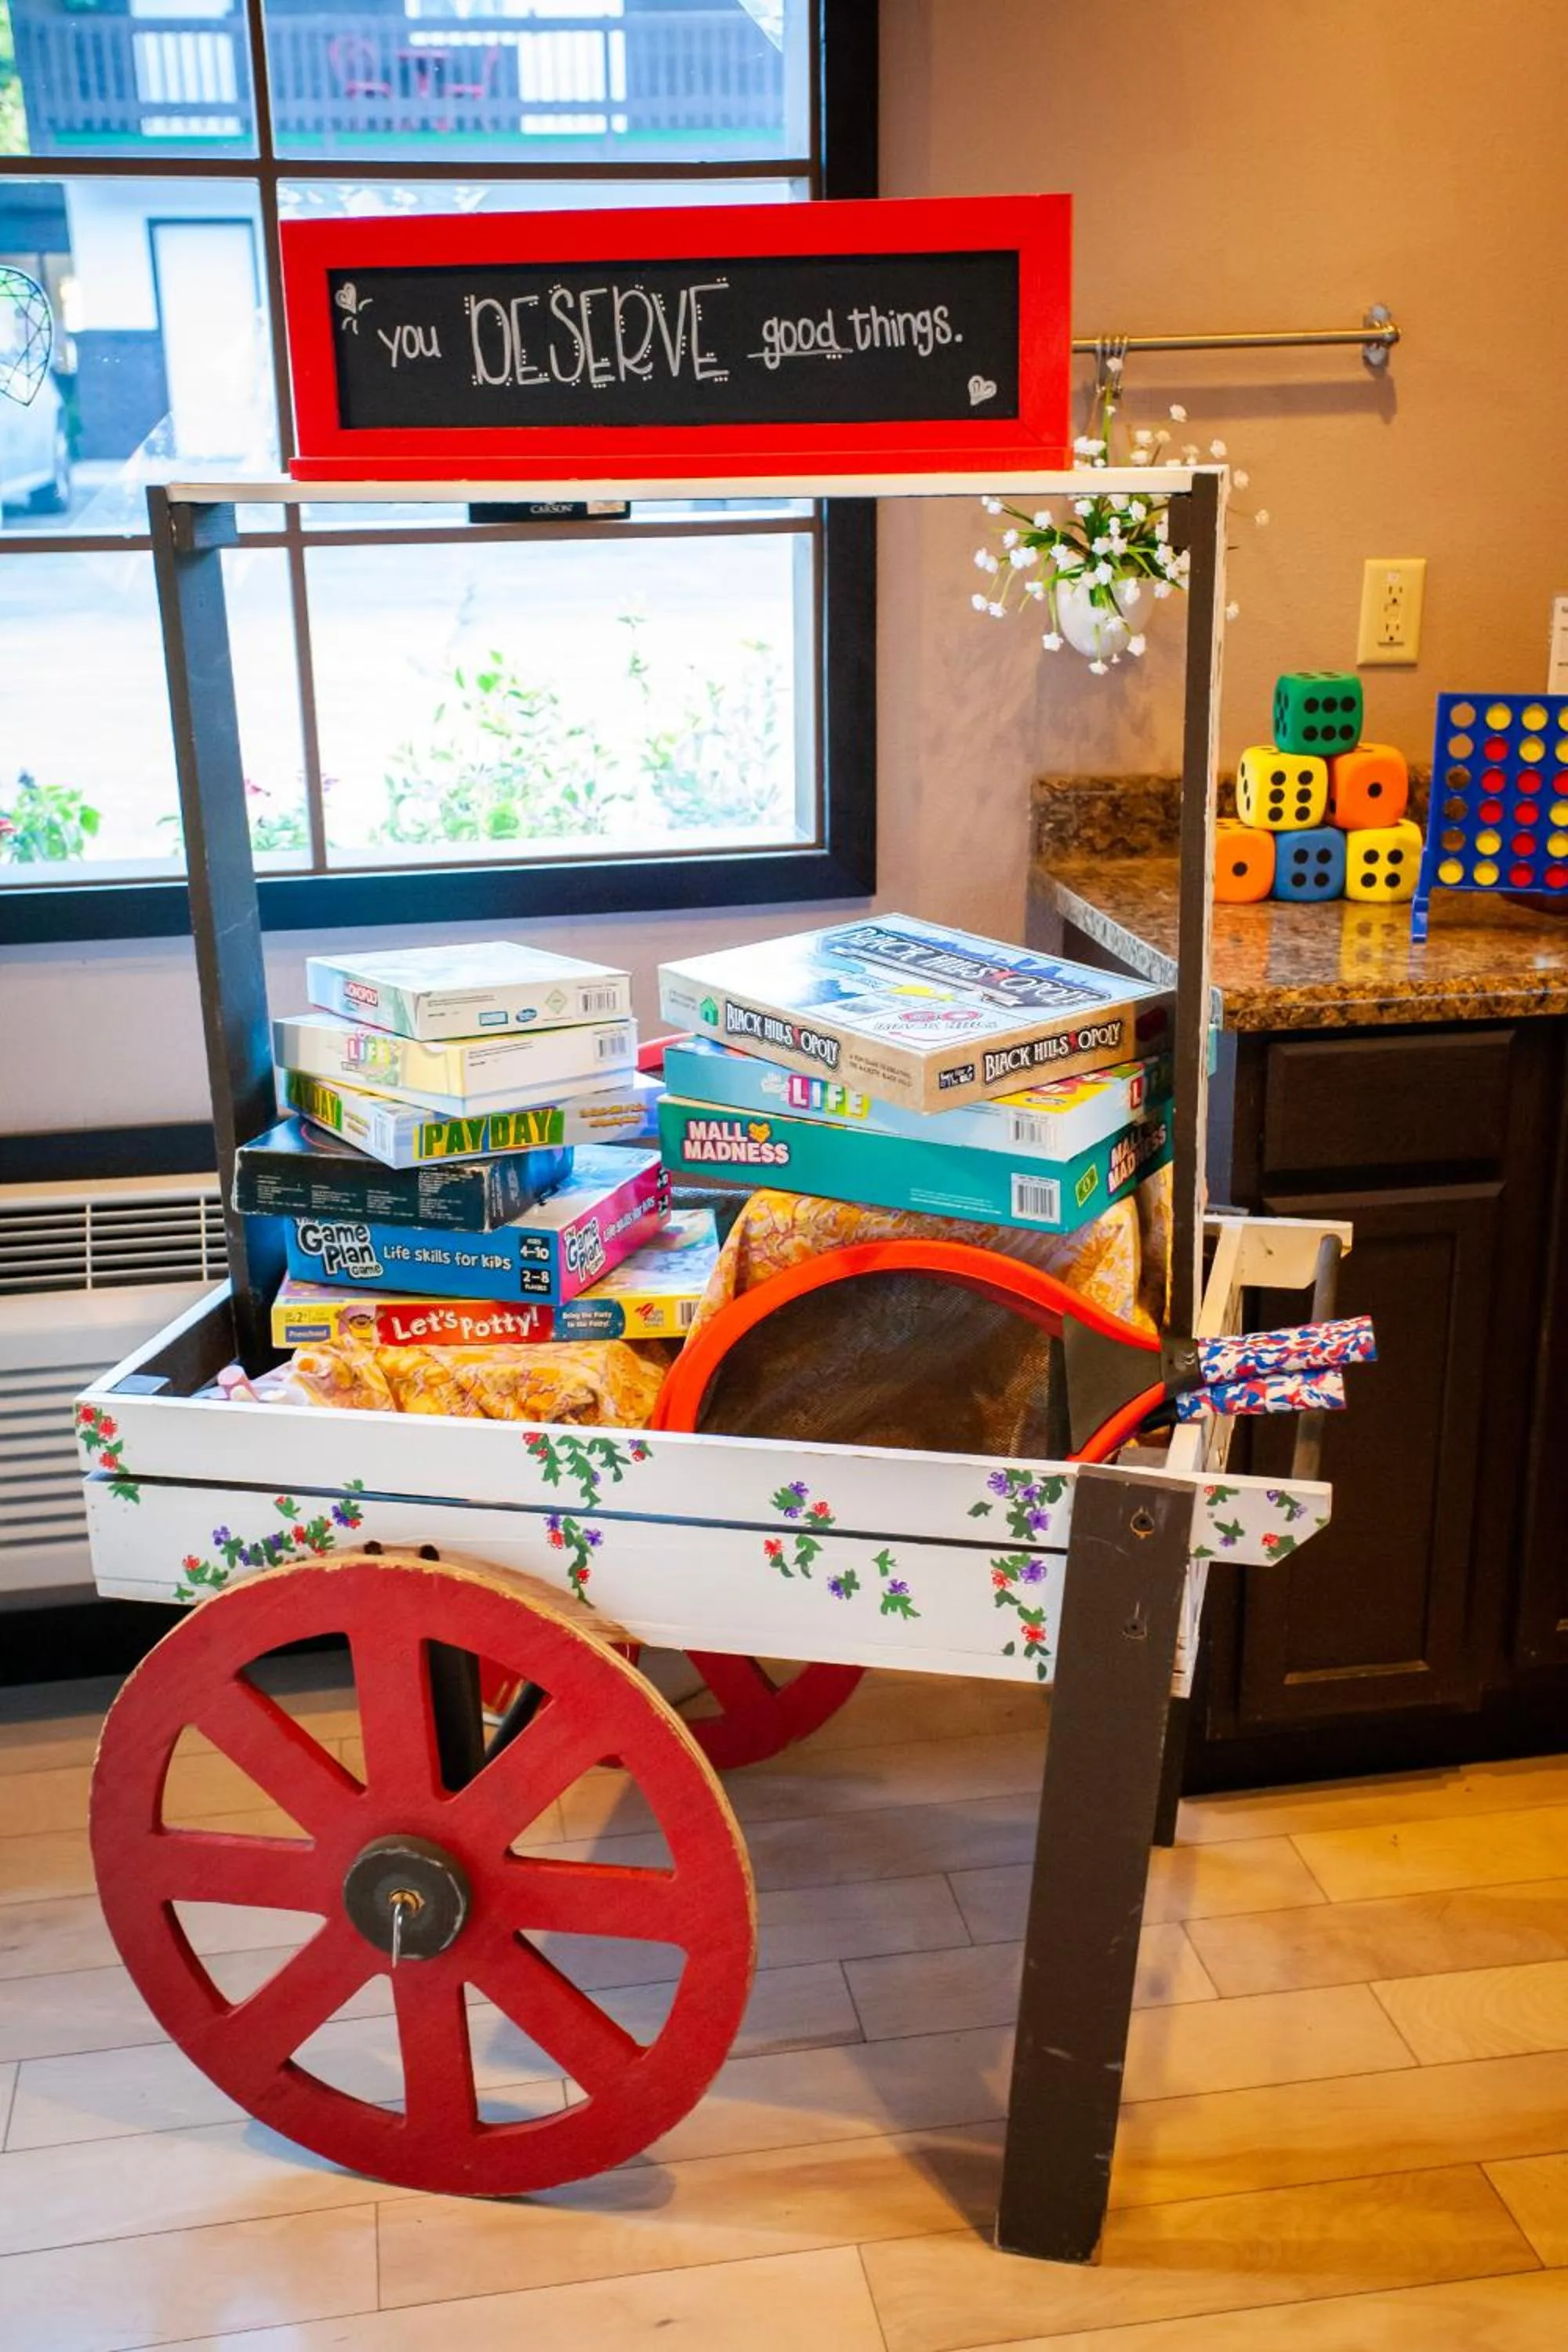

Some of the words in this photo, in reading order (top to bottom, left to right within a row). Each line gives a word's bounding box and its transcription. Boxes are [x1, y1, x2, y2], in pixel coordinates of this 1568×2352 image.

[379, 324, 441, 367] you
[468, 280, 730, 387] DESERVE
[761, 307, 837, 368] good
[848, 305, 964, 357] things.
[530, 504, 572, 514] CARSON
[726, 1003, 763, 1037] BLACK
[764, 1017, 793, 1046] HILLS
[984, 1047, 1030, 1083] BLACK
[1034, 1035, 1069, 1062] HILLS
[792, 1076, 865, 1116] LIFE
[688, 1121, 747, 1142] MALL
[683, 1139, 790, 1163] MADNESS
[299, 1223, 370, 1254] Game
[325, 1243, 375, 1272] Plan
[383, 1245, 410, 1260] Life
[414, 1248, 451, 1265] skills
[455, 1251, 478, 1267] for
[391, 1309, 459, 1341] Let's
